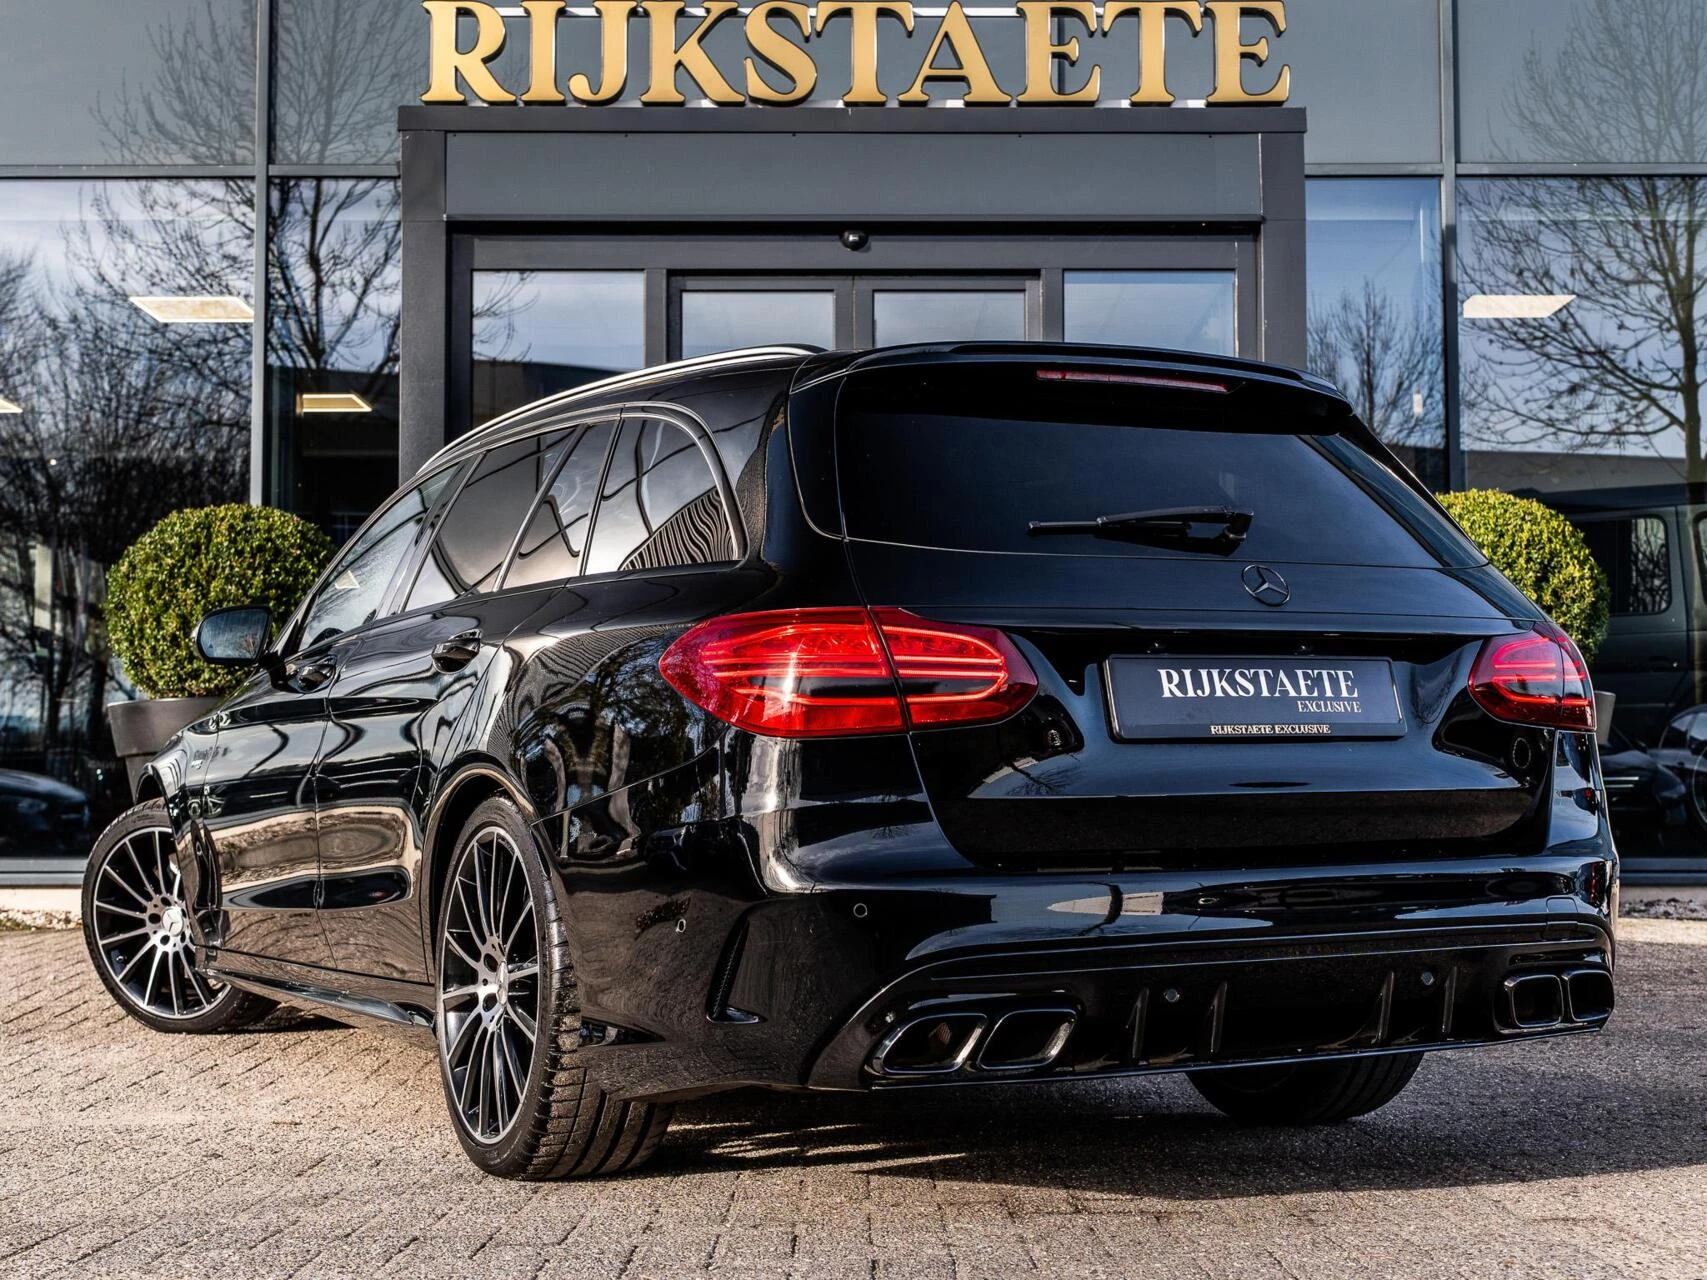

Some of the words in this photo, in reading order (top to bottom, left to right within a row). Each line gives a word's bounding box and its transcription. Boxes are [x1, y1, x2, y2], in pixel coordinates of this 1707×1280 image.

[420, 0, 1291, 106] RIJKSTAETE
[1157, 668, 1359, 698] RIJKSTAETE
[1297, 700, 1362, 713] EXCLUSIVE
[1210, 724, 1274, 735] RIJKSTAETE
[1275, 724, 1331, 734] EXCLUSIVE
